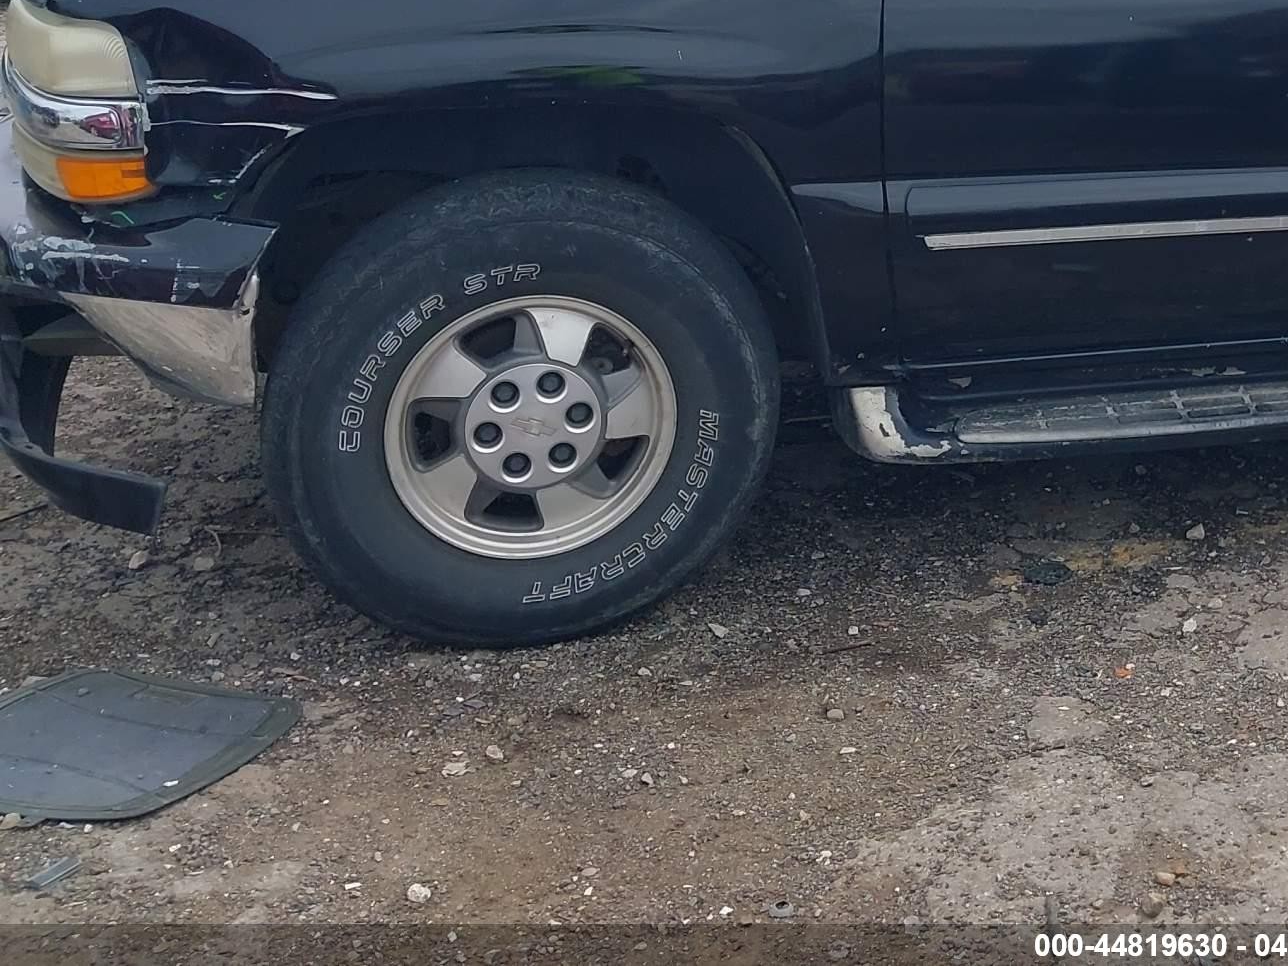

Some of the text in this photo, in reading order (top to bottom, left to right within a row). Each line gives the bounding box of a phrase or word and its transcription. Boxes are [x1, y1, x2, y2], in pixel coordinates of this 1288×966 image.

[338, 263, 541, 452] COURSER STR
[522, 409, 719, 603] MASTERCRAFT
